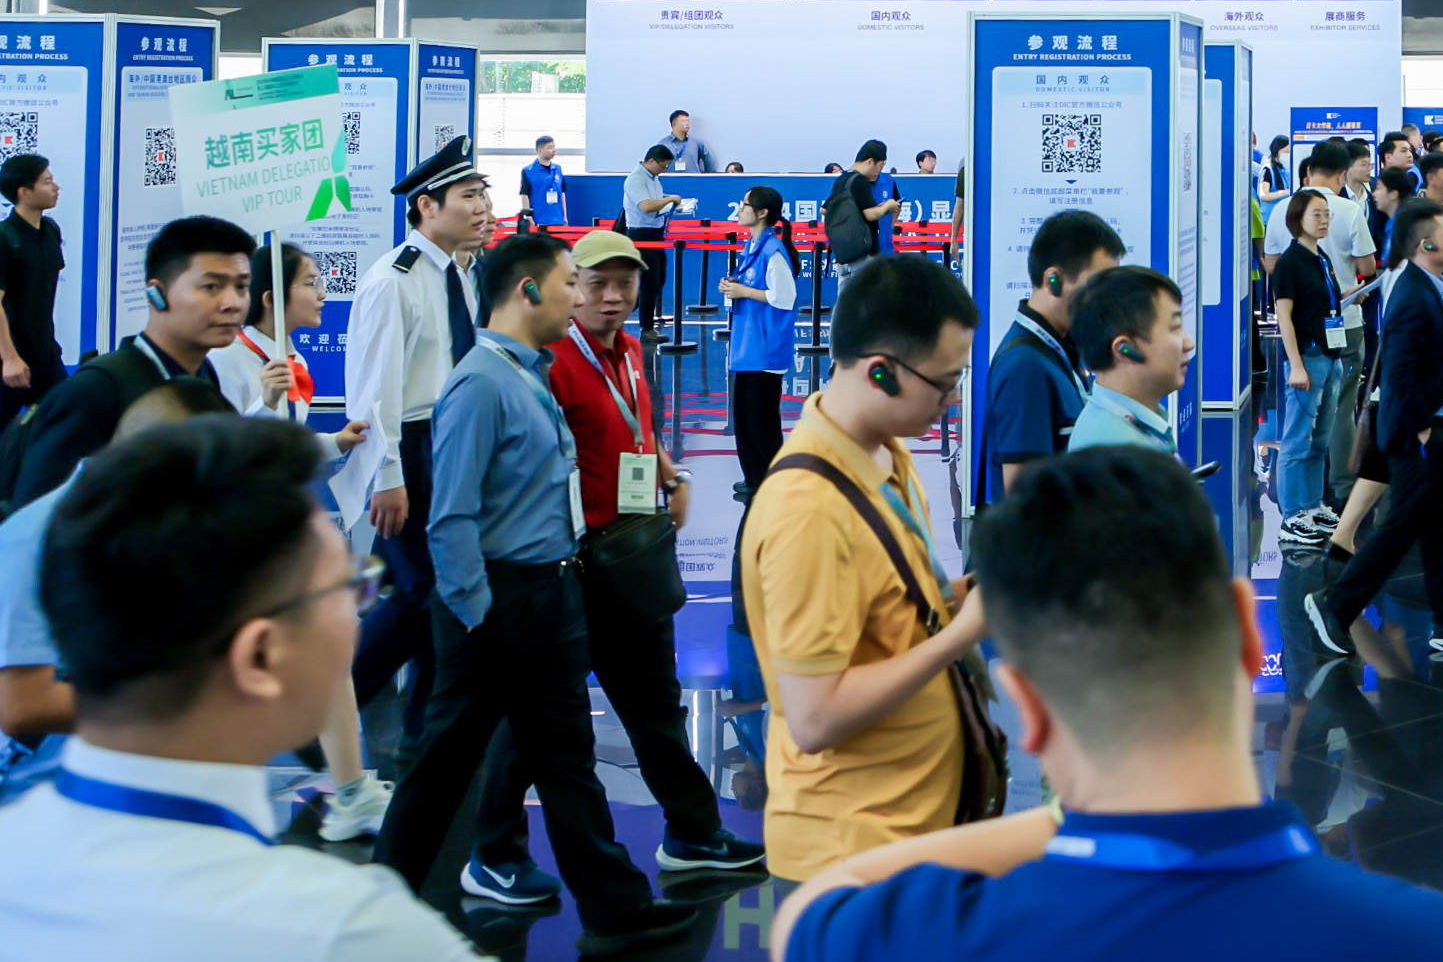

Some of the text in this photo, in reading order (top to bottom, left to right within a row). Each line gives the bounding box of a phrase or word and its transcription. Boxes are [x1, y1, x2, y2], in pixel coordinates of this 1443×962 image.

[661, 10, 724, 21] 贵宾/组团观众
[870, 11, 911, 21] 国内观众
[1224, 11, 1264, 21] 海外观众
[1325, 11, 1366, 21] 展商服务
[141, 37, 187, 52] 参观流程
[1027, 35, 1118, 50] 参观流程
[1036, 75, 1110, 85] 国内观众
[205, 119, 324, 170] 越南买家团
[196, 156, 331, 198] VIETNAM DELEGATIO
[242, 186, 302, 213] VIP TOUR
